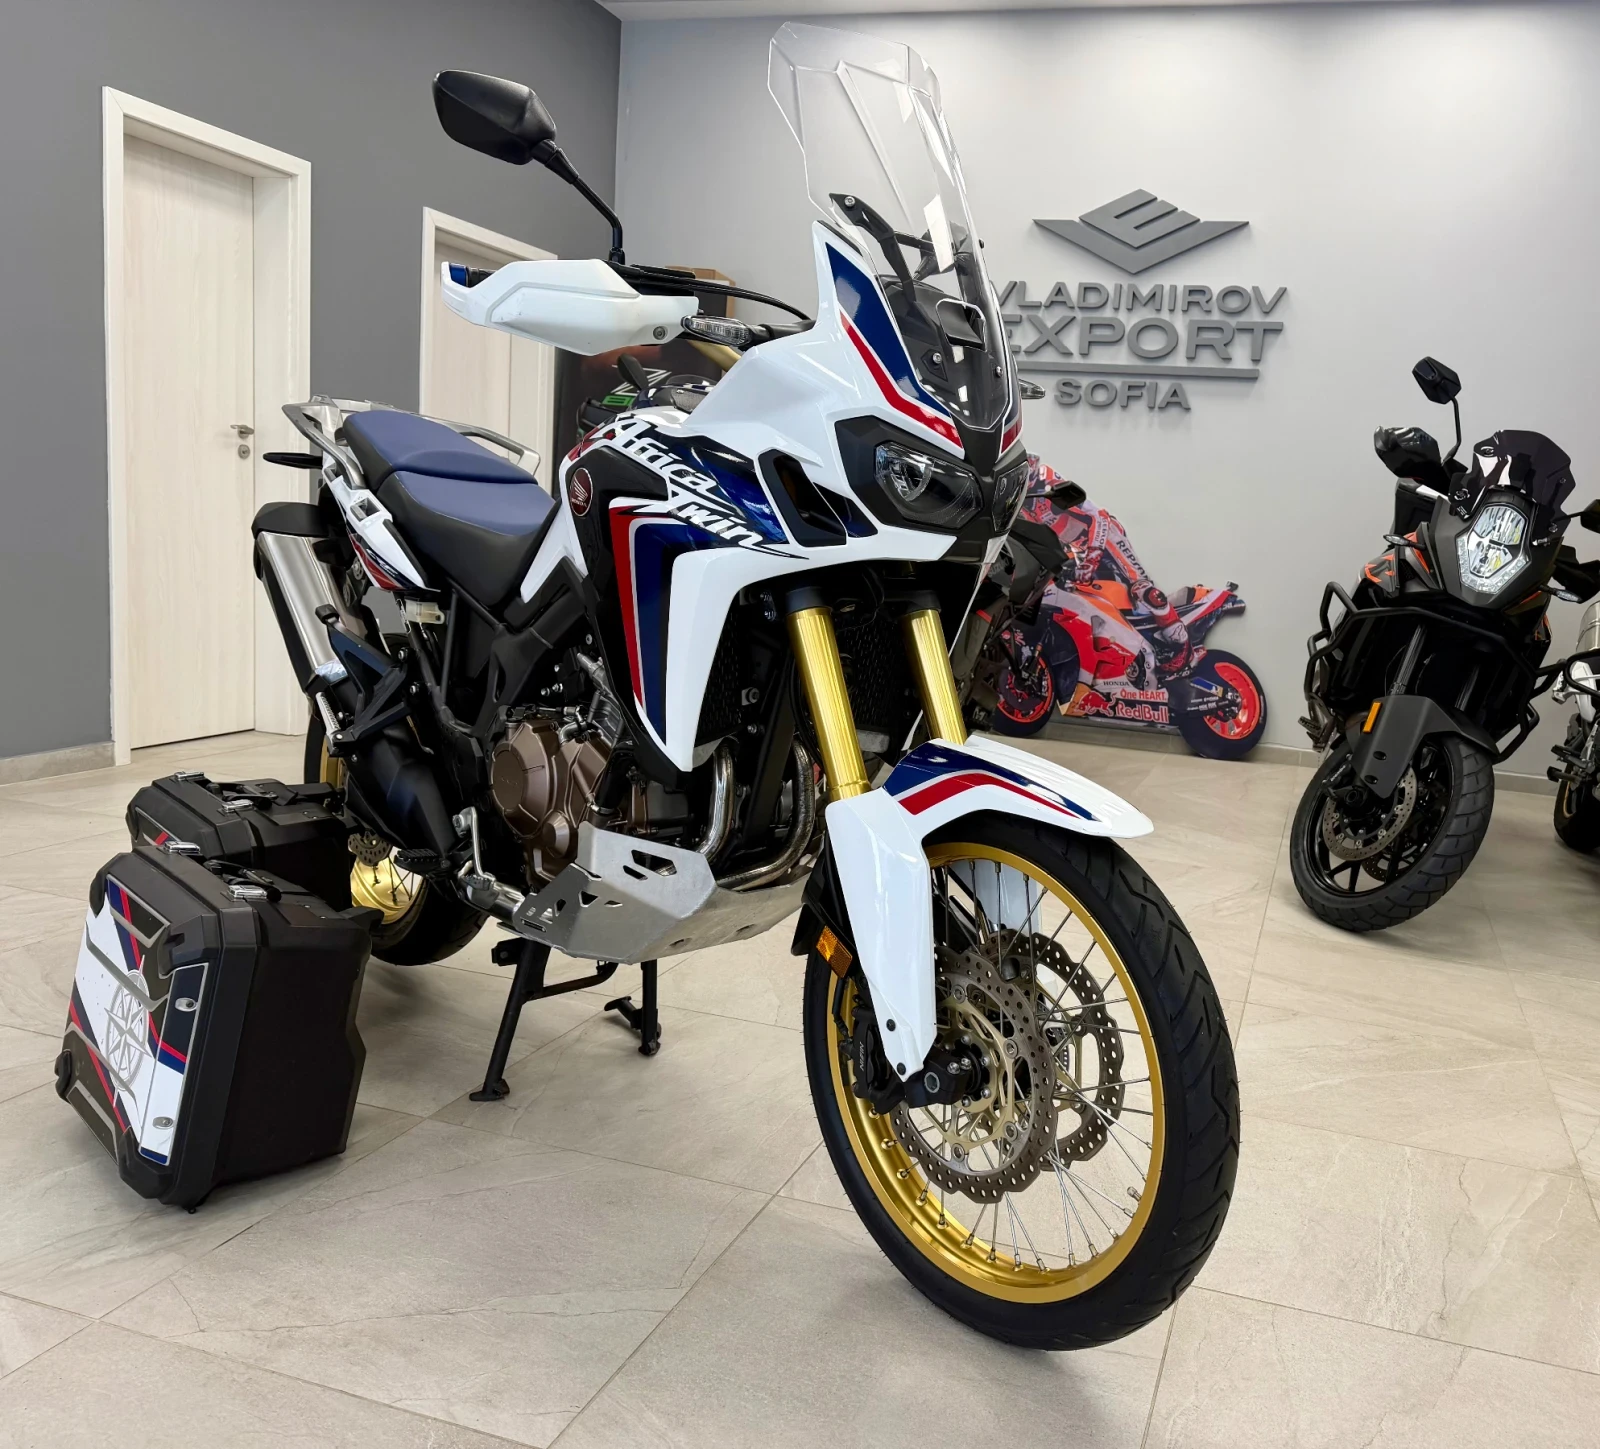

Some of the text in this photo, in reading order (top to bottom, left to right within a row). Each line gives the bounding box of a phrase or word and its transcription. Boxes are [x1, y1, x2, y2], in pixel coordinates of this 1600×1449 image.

[1054, 378, 1191, 410] SOFIA
[606, 418, 718, 492] Africa
[667, 482, 764, 548] Twin
[1120, 688, 1137, 700] One
